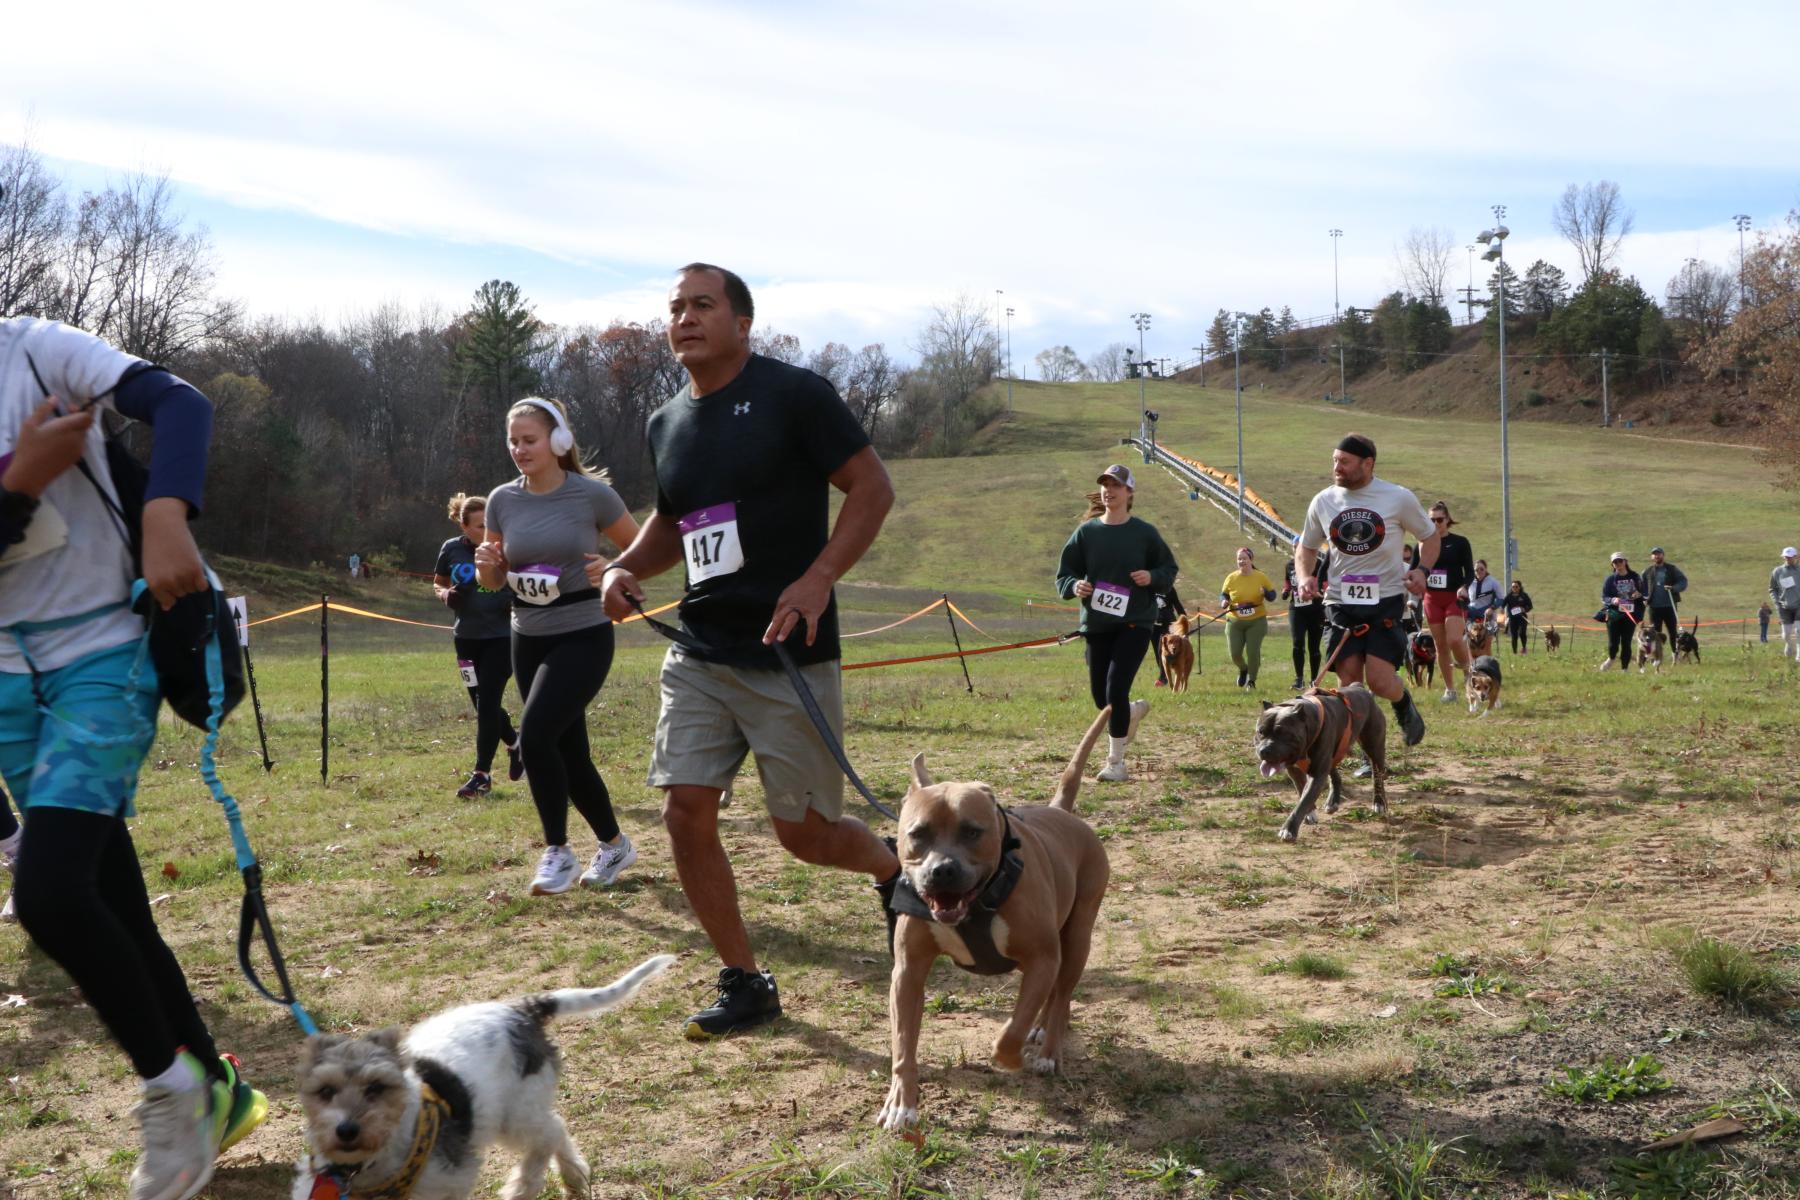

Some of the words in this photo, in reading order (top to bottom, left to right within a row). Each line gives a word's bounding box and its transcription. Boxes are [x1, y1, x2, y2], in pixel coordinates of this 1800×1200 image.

[1341, 511, 1373, 521] DIESEL
[692, 530, 725, 568] 417
[1346, 543, 1370, 552] DOGS
[517, 577, 549, 597] 434
[1429, 576, 1443, 585] 461
[1348, 585, 1372, 599] 421
[1097, 592, 1122, 610] 422
